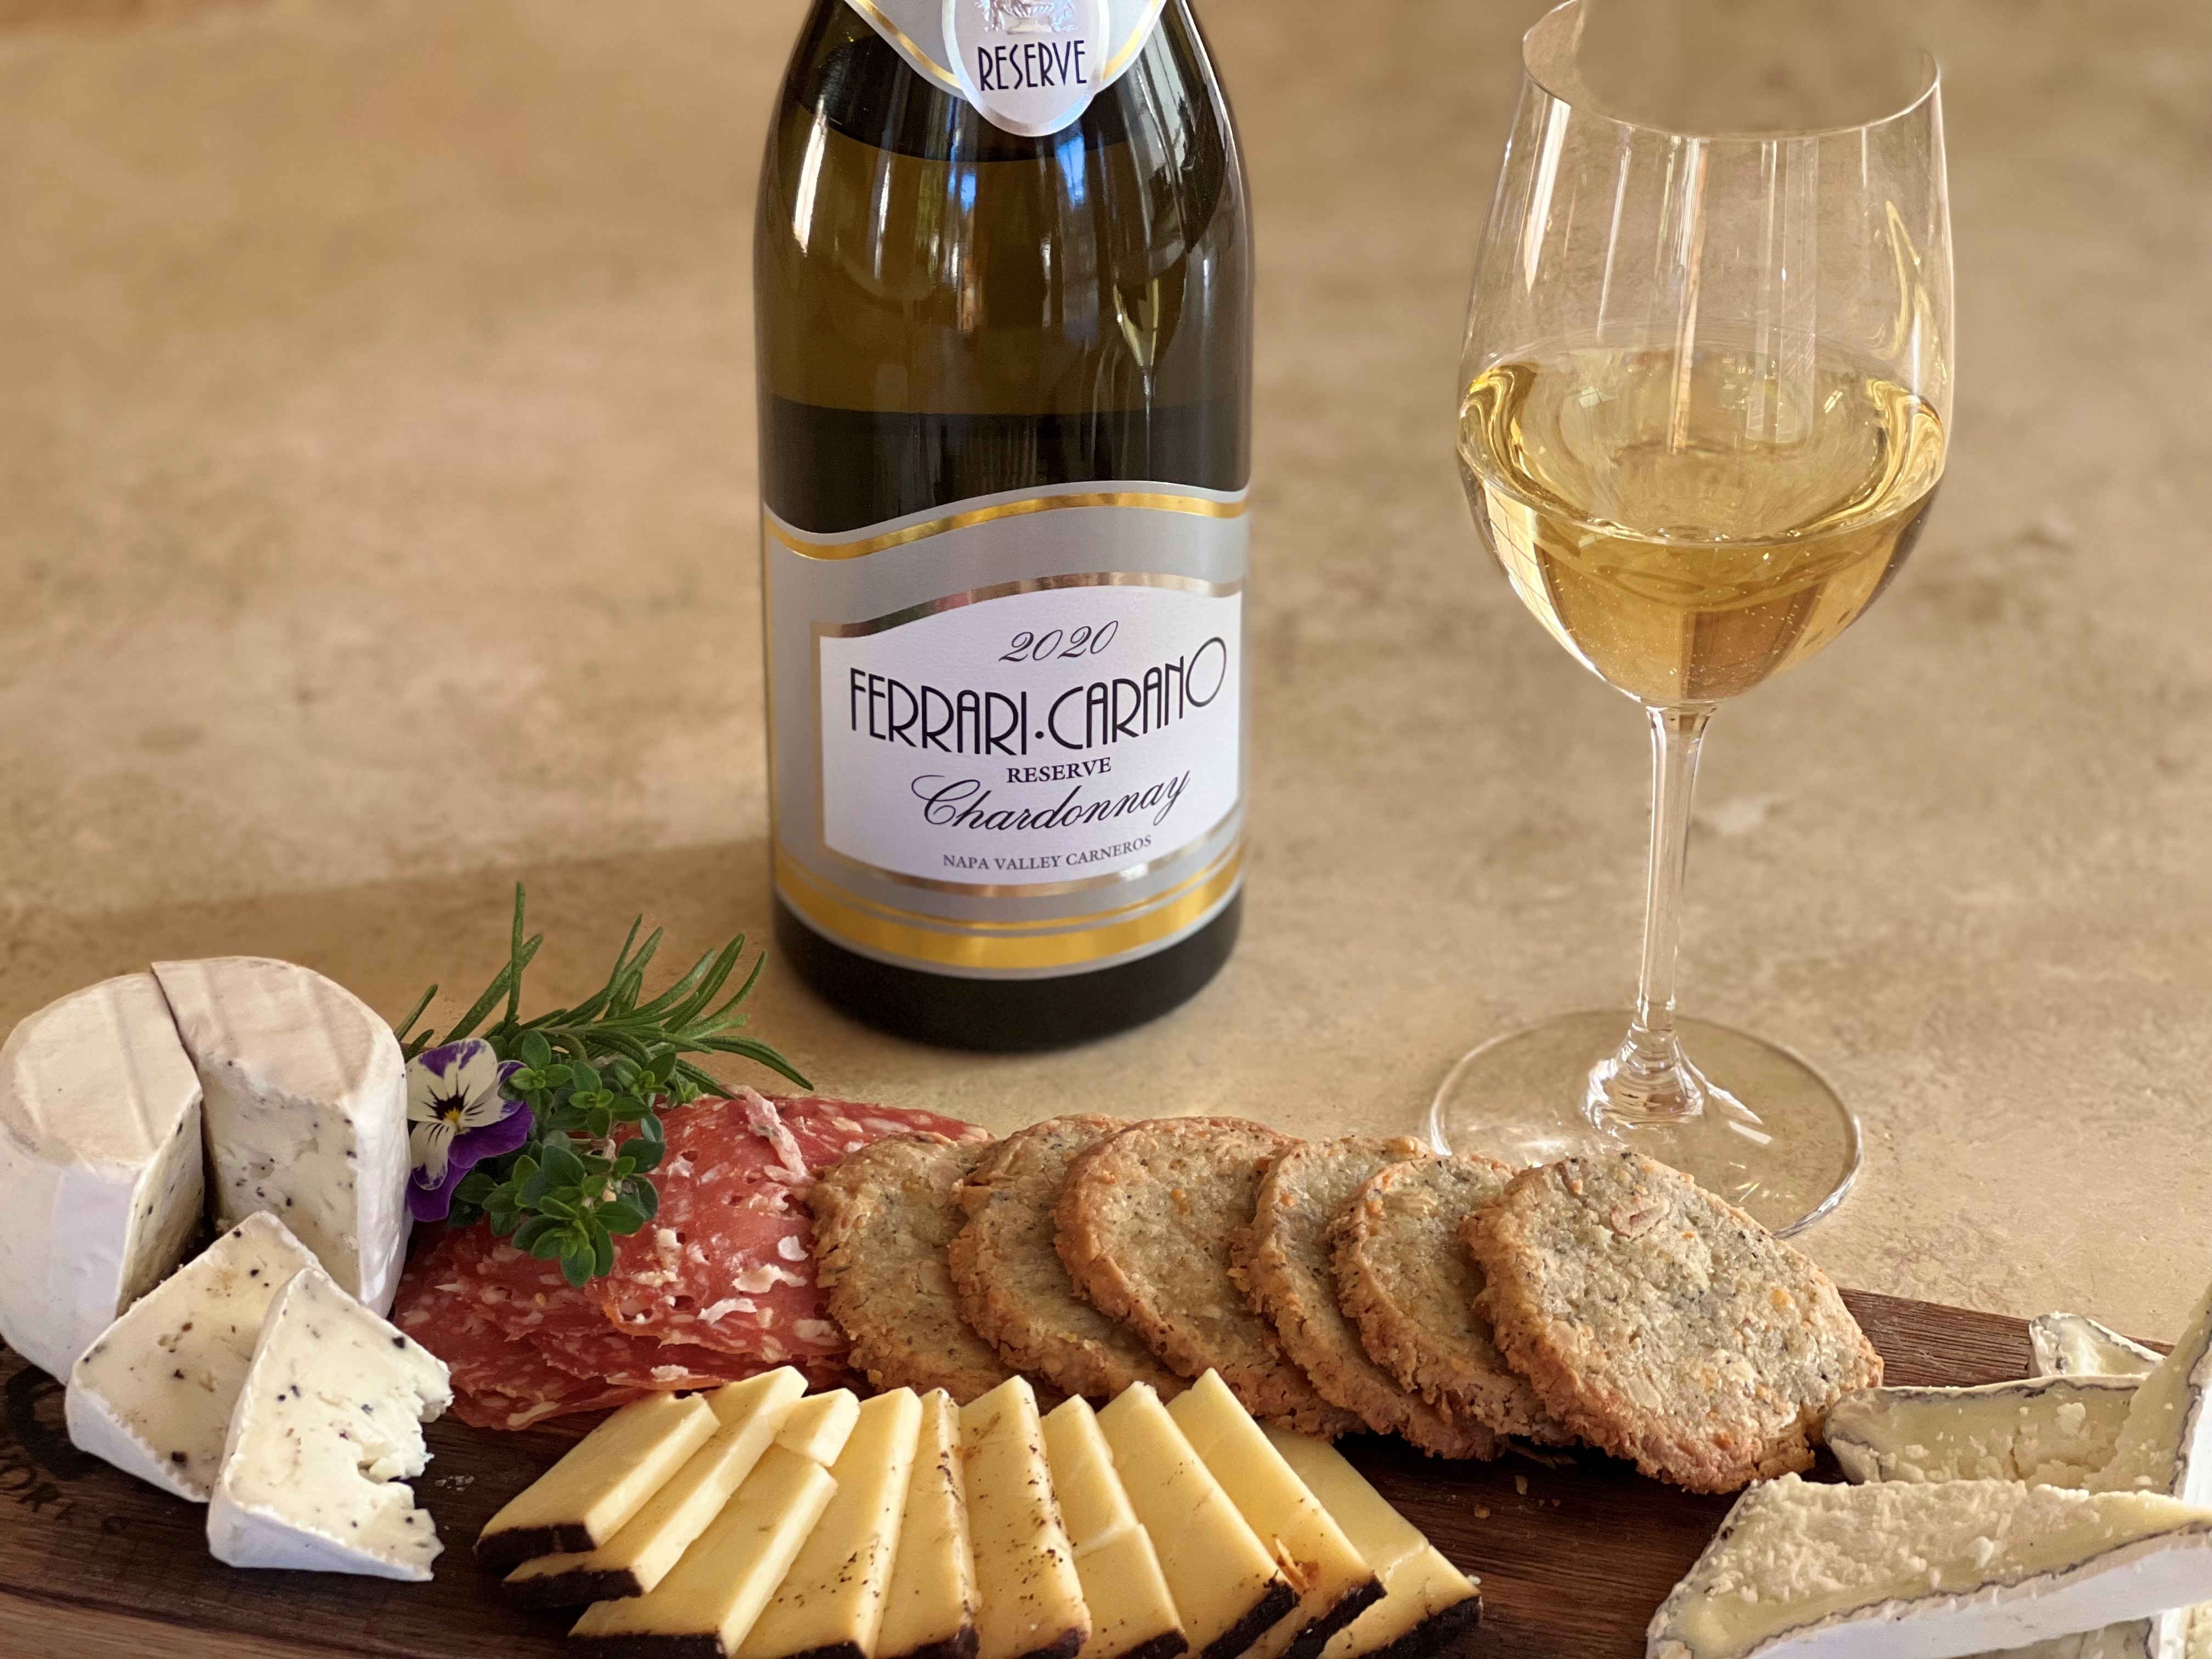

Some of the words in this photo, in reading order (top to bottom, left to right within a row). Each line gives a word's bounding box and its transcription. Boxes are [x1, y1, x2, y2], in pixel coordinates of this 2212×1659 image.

[978, 40, 1087, 92] RESERVE
[998, 620, 1119, 662] 2020
[1006, 757, 1111, 783] RESERVE
[911, 770, 1190, 831] Chardonnay
[943, 854, 990, 870] NAPA
[994, 855, 1062, 870] VALLEY
[1065, 836, 1152, 866] CARNEROS
